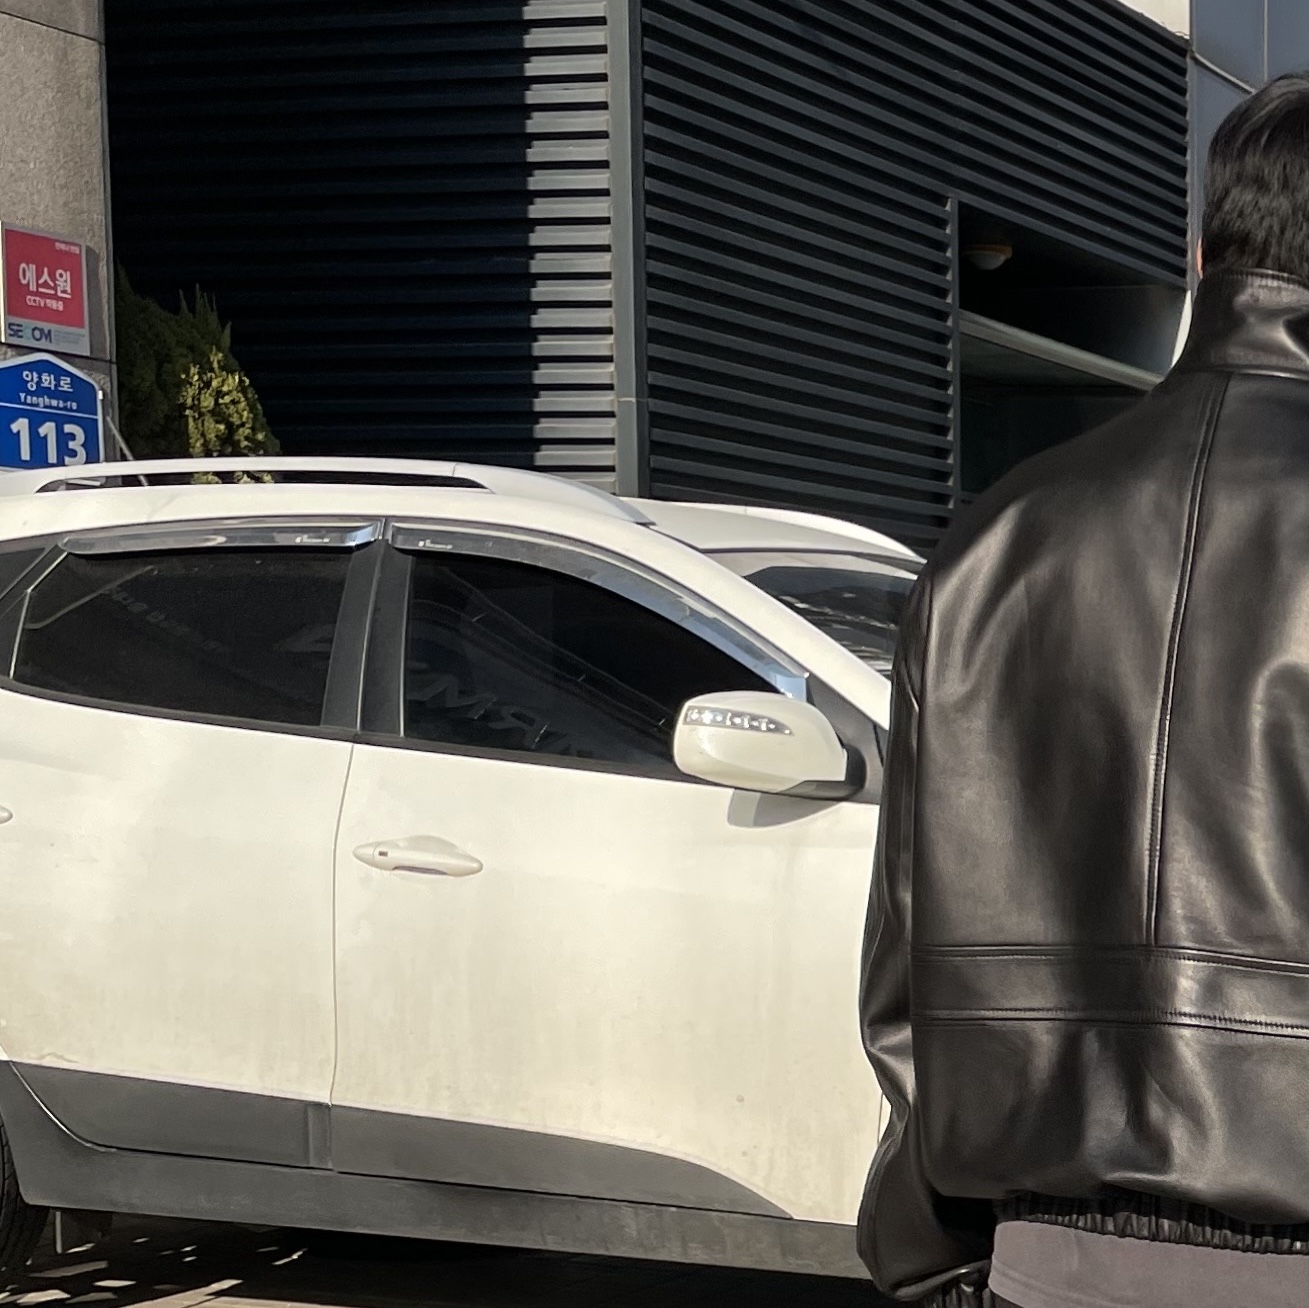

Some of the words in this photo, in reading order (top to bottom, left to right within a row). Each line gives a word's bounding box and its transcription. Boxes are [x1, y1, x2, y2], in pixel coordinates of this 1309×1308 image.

[19, 262, 72, 299] 에스원
[26, 295, 45, 308] CCTV
[22, 370, 74, 393] 양화로
[19, 392, 78, 411] Yanghwa-ro
[10, 417, 87, 466] 113
